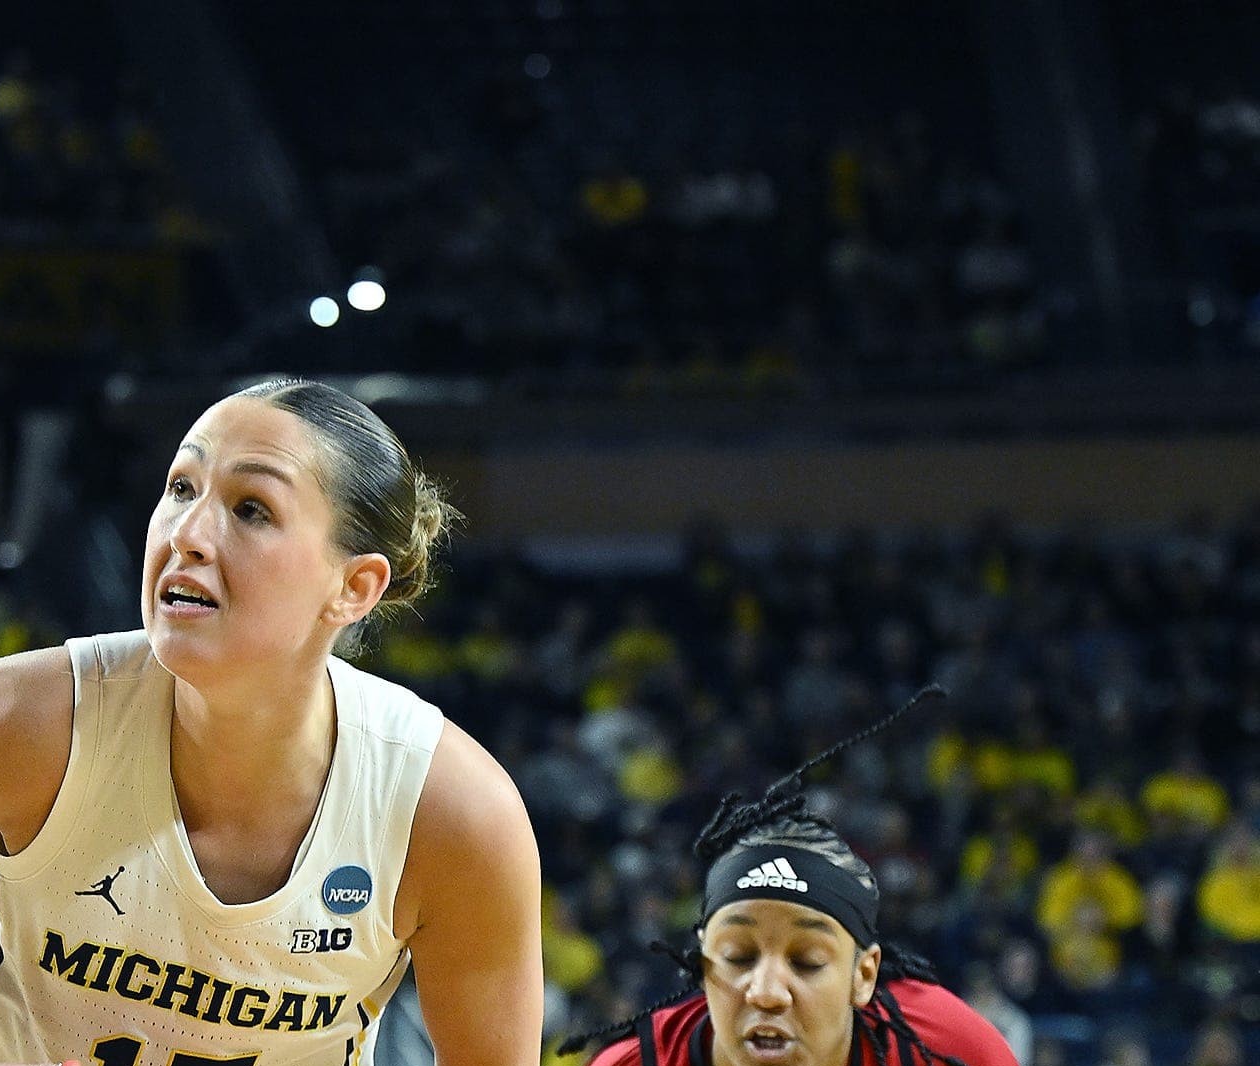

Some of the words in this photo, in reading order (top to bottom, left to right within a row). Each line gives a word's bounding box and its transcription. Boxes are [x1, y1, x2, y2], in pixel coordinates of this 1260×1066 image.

[736, 872, 808, 893] adidas
[327, 889, 369, 903] NCAA
[38, 927, 352, 1033] MICHIGAN
